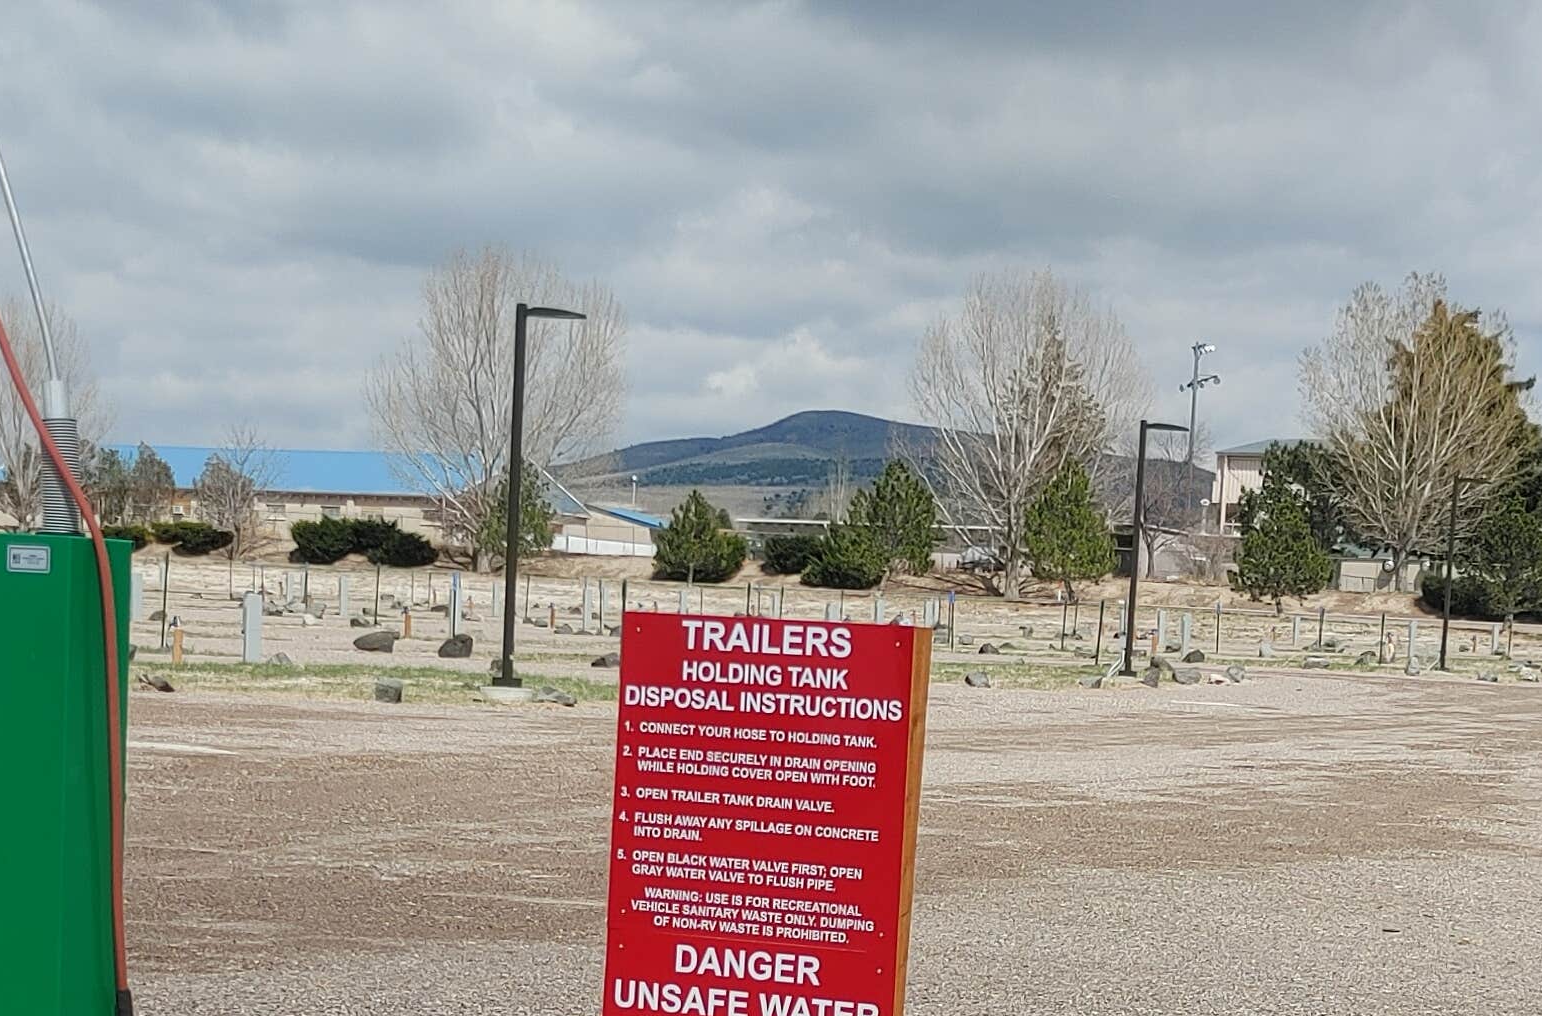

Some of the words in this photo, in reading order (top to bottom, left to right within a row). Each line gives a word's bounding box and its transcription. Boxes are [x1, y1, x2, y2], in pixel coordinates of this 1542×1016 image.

[681, 619, 852, 658] TRAILERS
[682, 660, 783, 686] HOLDING
[787, 666, 849, 690] TANK
[624, 684, 735, 712] DISPOSAL
[739, 691, 902, 722] INSTRUCTIONS
[624, 720, 634, 732] 1.
[639, 721, 696, 736] CONNECT
[697, 725, 731, 739] YOUR
[733, 727, 767, 741] HOSE
[768, 730, 786, 742] TO
[787, 731, 841, 746] HOLDING
[843, 734, 877, 749] TANK.
[622, 744, 633, 757] 2.
[638, 745, 677, 760] PLACE
[679, 748, 704, 762] END
[705, 750, 768, 767] SECURELY
[769, 755, 782, 768] IN
[784, 756, 821, 770] DRAIN
[823, 759, 877, 774] OPENING
[637, 759, 675, 773] WHILE
[676, 762, 729, 777] HOLDING
[731, 766, 773, 781] COVER
[775, 769, 808, 783] OPEN
[810, 772, 840, 786] WITH
[620, 785, 630, 798] 3.
[635, 787, 669, 801] OPEN
[670, 789, 721, 805] TRAILER
[722, 793, 754, 807] TANK
[755, 795, 793, 810] DRAIN
[795, 799, 835, 813] VALVE.
[618, 810, 629, 822] 4.
[634, 811, 673, 826] FLUSH
[673, 814, 708, 828] AWAY
[707, 817, 734, 830] ANY
[734, 819, 793, 835] SPILLAGE
[794, 824, 813, 837] ON
[814, 825, 879, 842] CONCRETE
[633, 825, 662, 838] INTO
[663, 827, 703, 841] DRAIN.
[617, 848, 627, 860] 5.
[632, 849, 665, 864] OPEN
[666, 852, 708, 867] BLACK
[709, 856, 750, 871] WATER
[752, 859, 789, 874] VALVE
[829, 866, 863, 880] OPEN
[631, 863, 664, 877] GRAY
[665, 866, 706, 881] WATER
[708, 869, 745, 884] VALVE
[747, 873, 764, 885] TO
[766, 874, 805, 889] FLUSH
[806, 878, 836, 892] PIPE.
[630, 899, 680, 915] VEHICLE
[681, 904, 740, 920] SANITARY
[741, 908, 783, 924] WASTE
[819, 916, 875, 932] DUMPING
[644, 886, 703, 903] WARNING:
[705, 892, 730, 905] USE
[731, 894, 743, 906] IS
[745, 895, 770, 909] FOR
[772, 898, 863, 917] RECREATIONAL
[653, 915, 670, 927] OF
[672, 916, 717, 932] NON-RV
[718, 920, 760, 936] WASTE
[762, 925, 774, 937] IS
[775, 926, 849, 944] PROHIBITED.
[675, 943, 820, 986] DANGER
